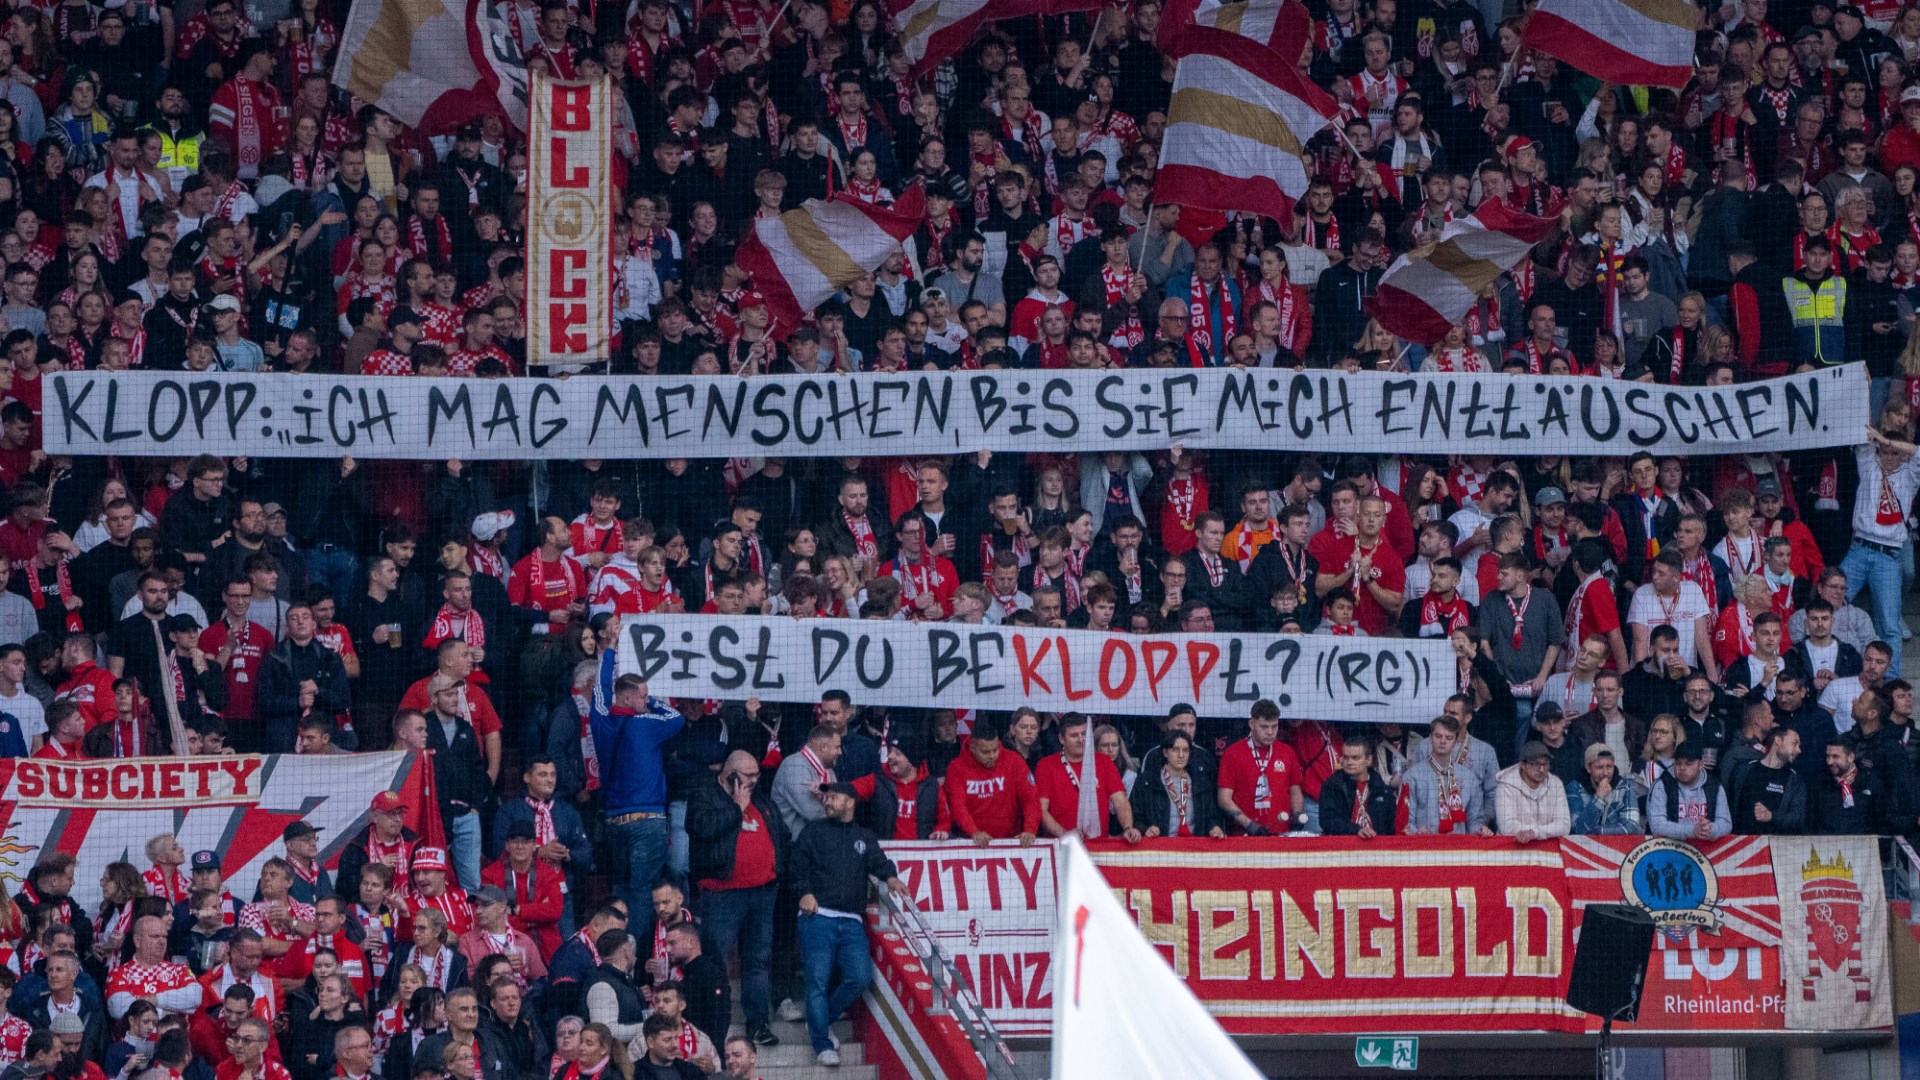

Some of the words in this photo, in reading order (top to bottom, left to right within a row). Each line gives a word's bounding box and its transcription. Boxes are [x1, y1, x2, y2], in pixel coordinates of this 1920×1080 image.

[428, 383, 568, 449] MAG
[588, 376, 960, 448] MENSCHEN,
[812, 627, 894, 689] DU
[17, 759, 261, 799] SUBCIETY
[966, 777, 1005, 794] ZITTY
[897, 858, 1042, 912] ZITTY
[941, 952, 1053, 1010] AINZ
